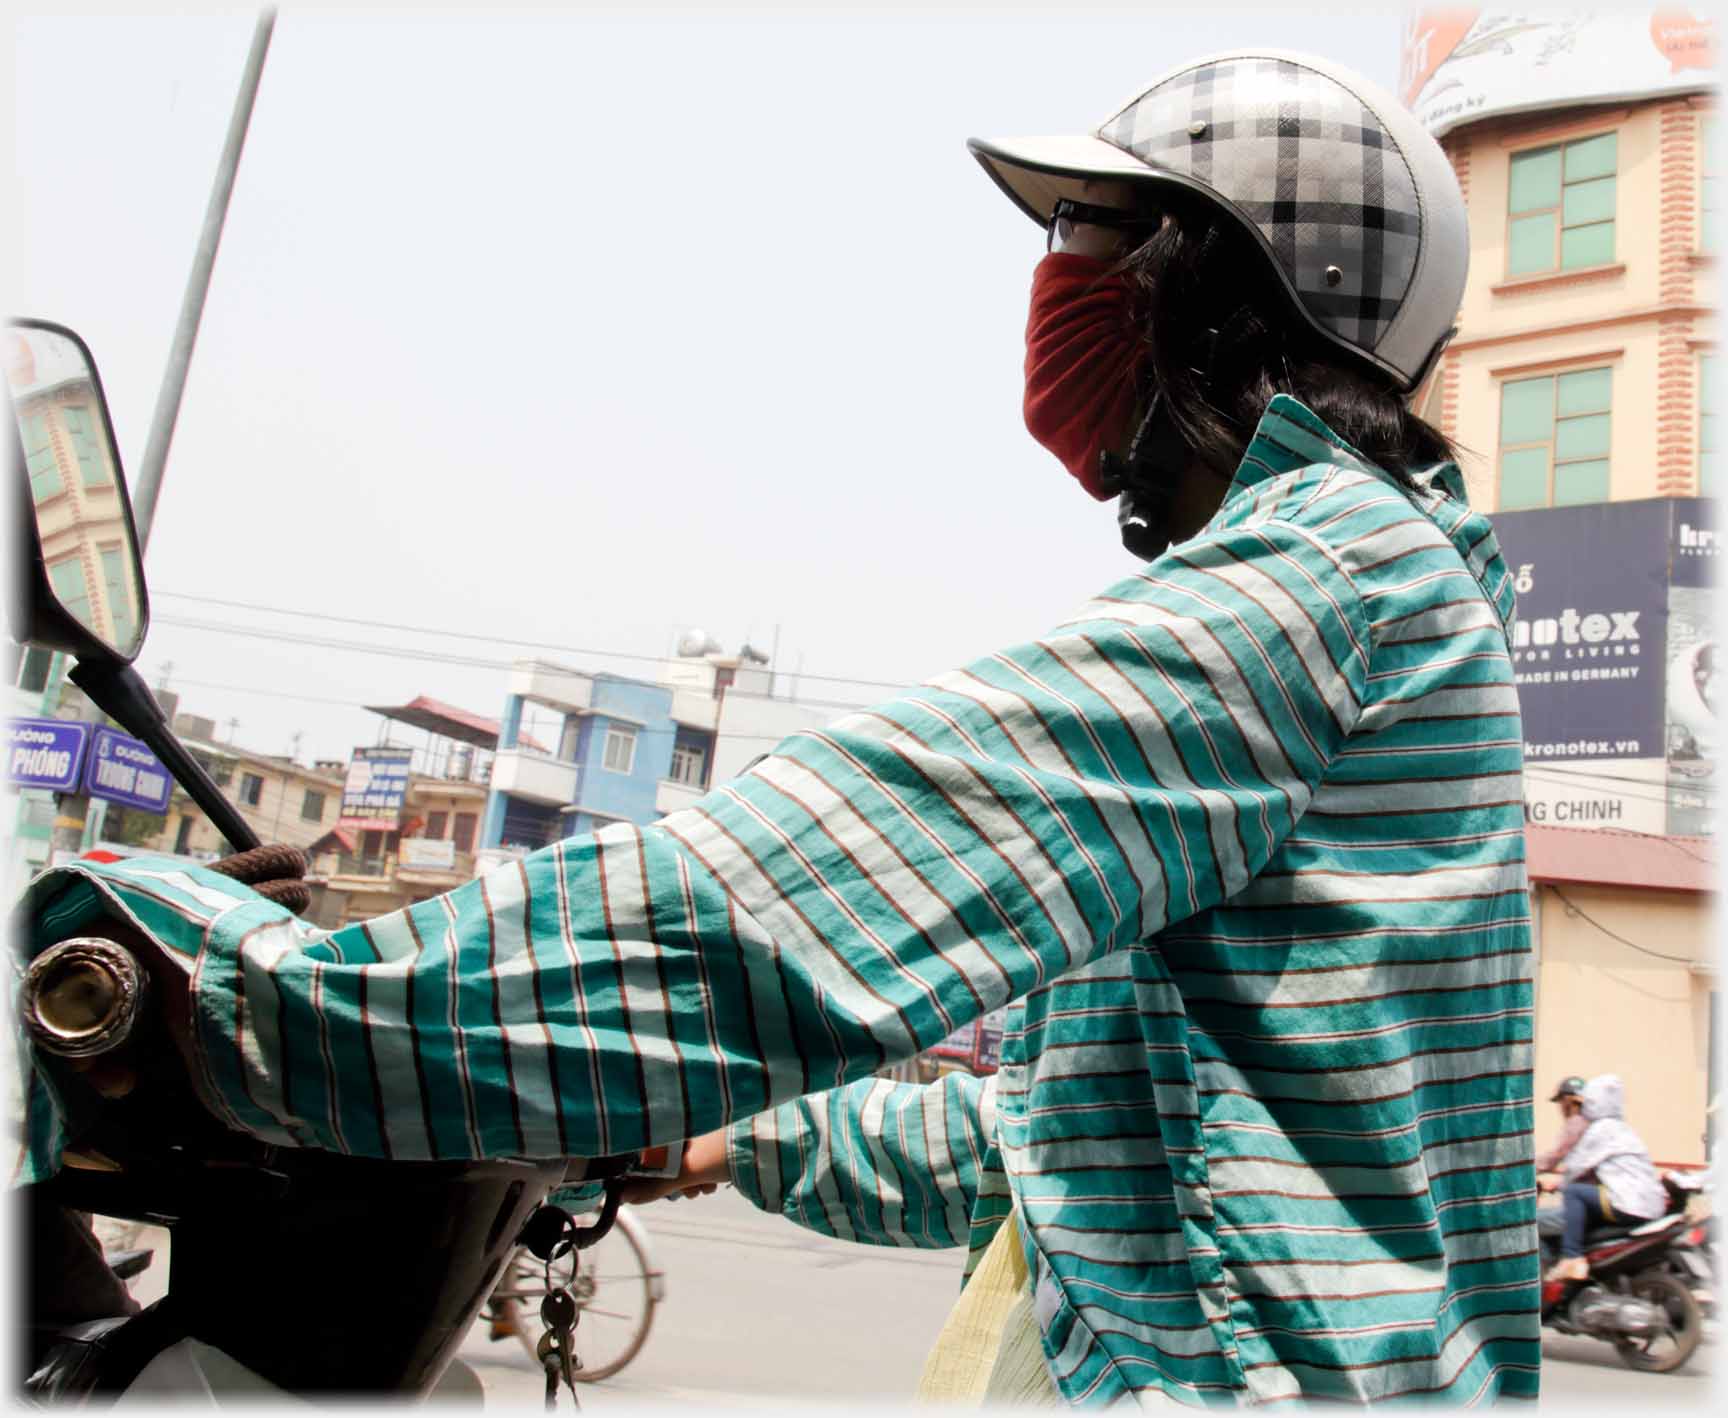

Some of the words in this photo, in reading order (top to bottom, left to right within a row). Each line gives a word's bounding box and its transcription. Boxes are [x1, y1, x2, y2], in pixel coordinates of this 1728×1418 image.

[1565, 643, 1640, 659] LIVING
[1554, 670, 1569, 682] IN
[1571, 666, 1640, 681] GERMANY
[1524, 740, 1640, 756] kronotex.vn
[1555, 800, 1622, 821] CHINH
